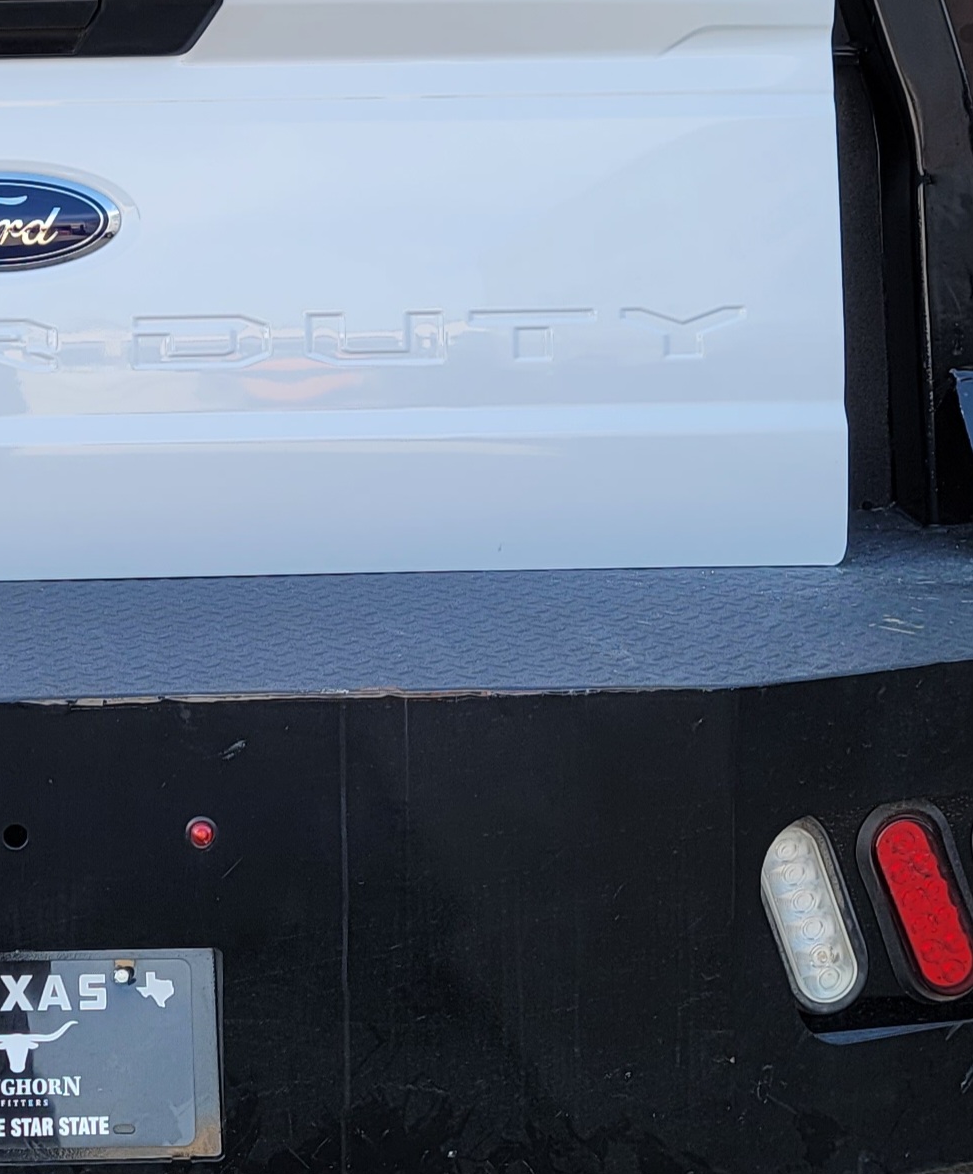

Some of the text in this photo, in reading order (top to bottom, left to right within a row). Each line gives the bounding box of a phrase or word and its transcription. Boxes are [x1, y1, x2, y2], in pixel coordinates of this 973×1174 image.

[130, 305, 747, 372] DUTY
[11, 1118, 53, 1138] STAR
[58, 1116, 110, 1136] STATE
